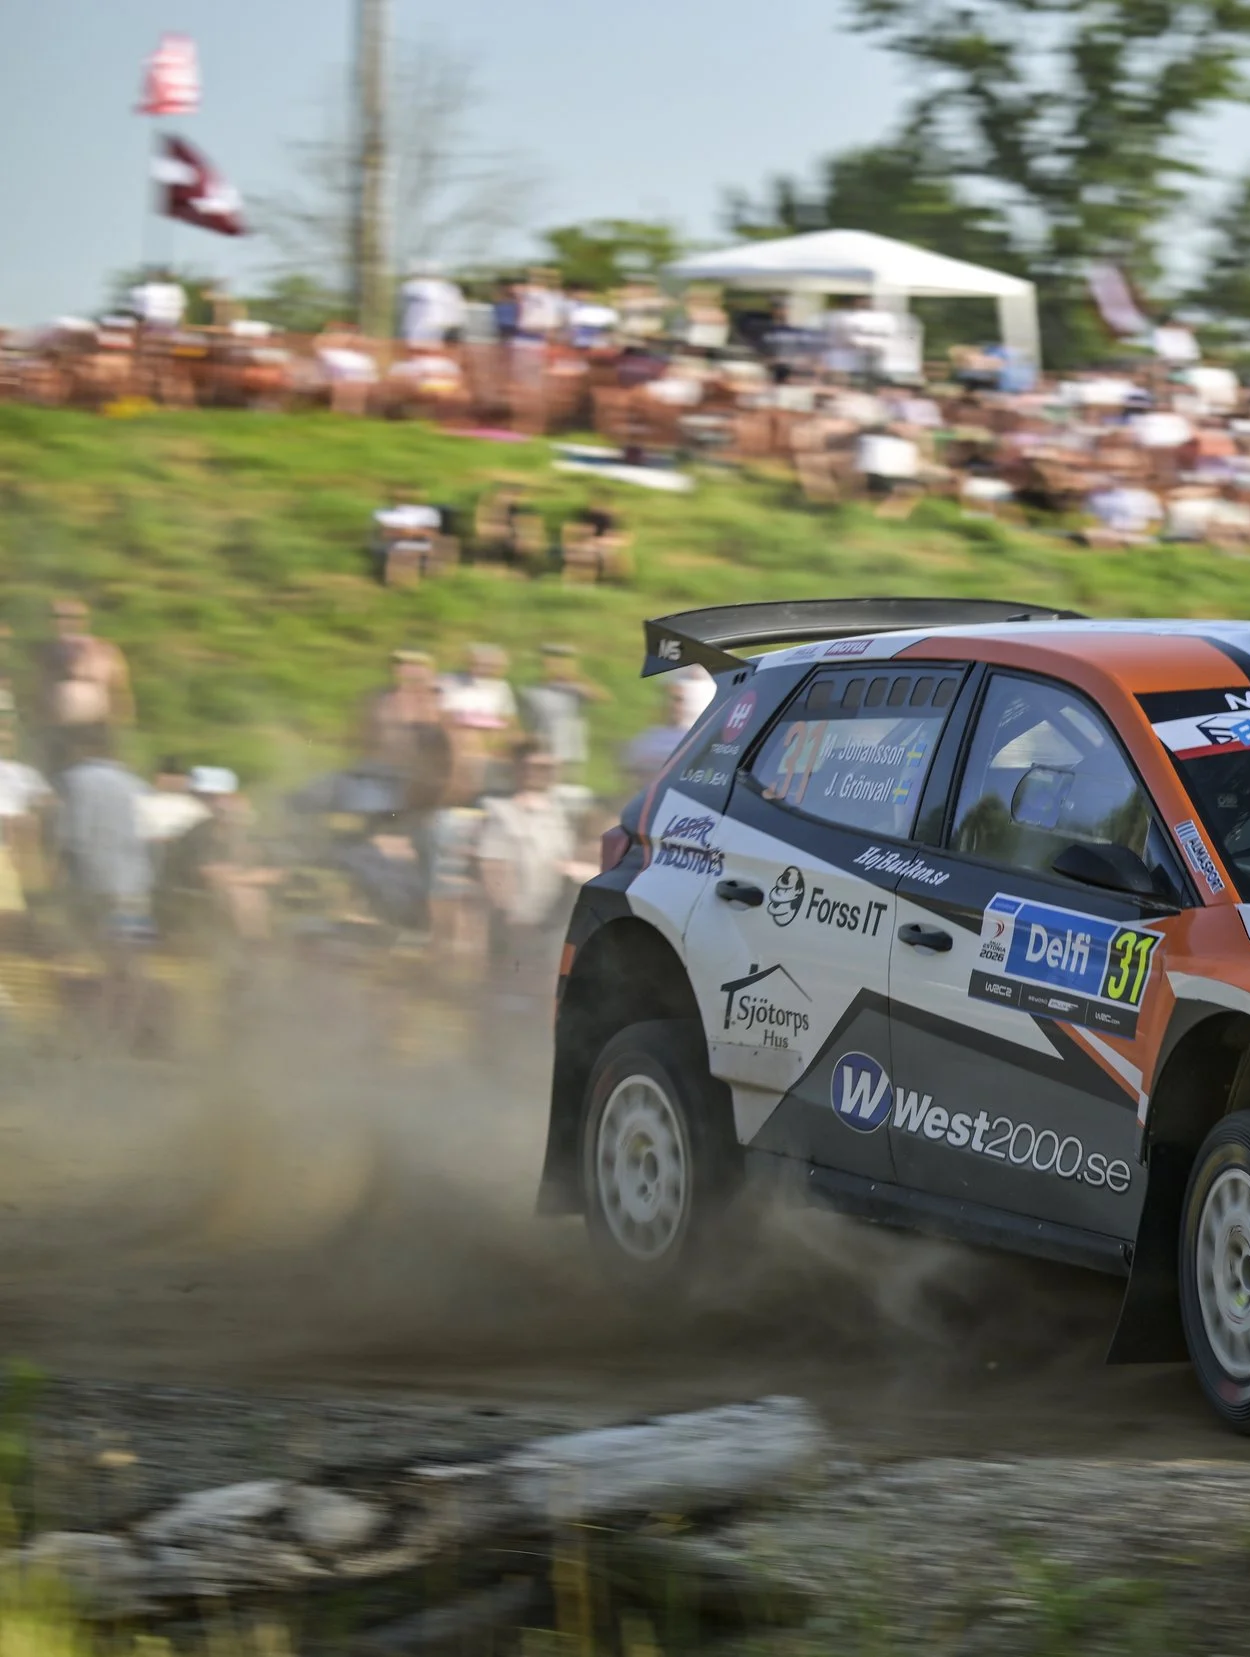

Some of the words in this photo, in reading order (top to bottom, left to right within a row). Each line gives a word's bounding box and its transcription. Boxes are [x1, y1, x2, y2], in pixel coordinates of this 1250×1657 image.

[762, 721, 829, 803] 31
[821, 733, 838, 759] M.
[839, 740, 905, 765] Johansson
[824, 773, 835, 796] J.
[840, 773, 895, 802] Grönvall
[1188, 840, 1224, 893] ALMASPORT
[805, 887, 860, 931] Forss
[862, 901, 888, 936] IT
[980, 951, 1004, 962] 2026
[982, 943, 1006, 953] ESTONIA
[1025, 923, 1092, 975] Delfi
[1108, 932, 1155, 1004] 31
[737, 995, 810, 1037] Sjötorps
[763, 1029, 789, 1048] Hus
[893, 1086, 1131, 1192] West2000.se
